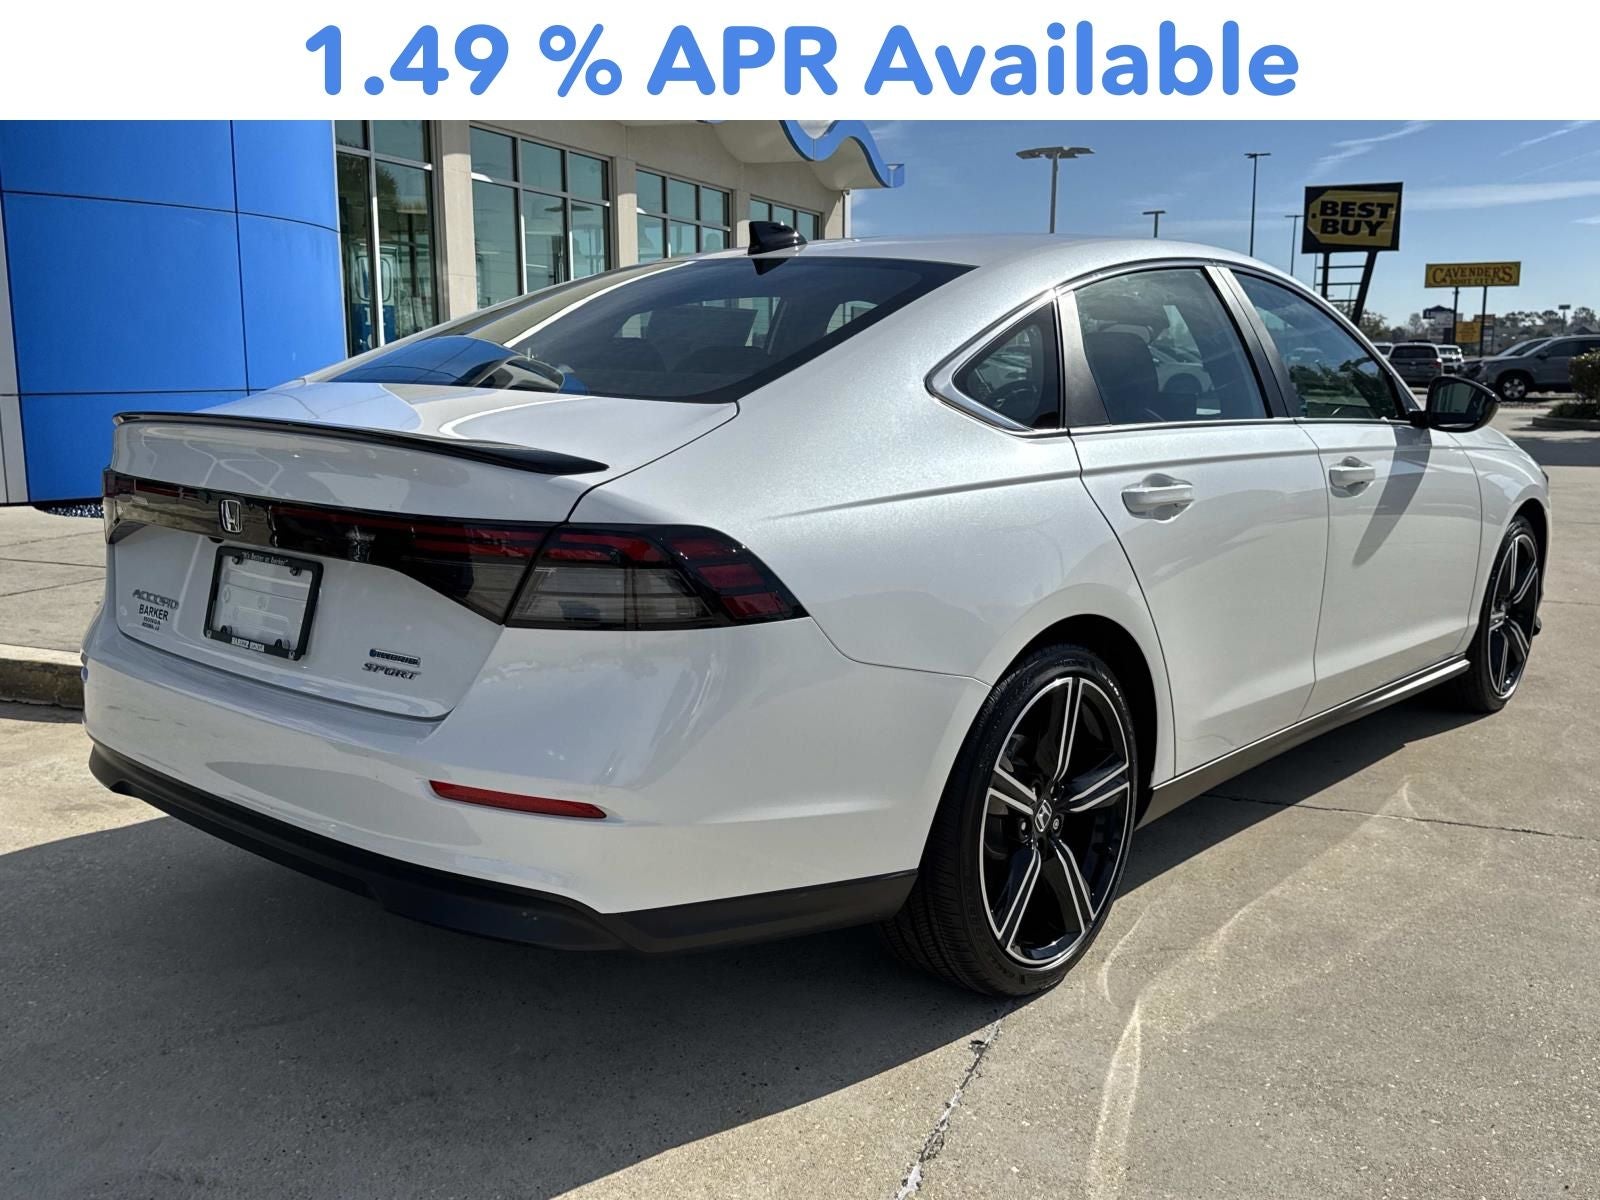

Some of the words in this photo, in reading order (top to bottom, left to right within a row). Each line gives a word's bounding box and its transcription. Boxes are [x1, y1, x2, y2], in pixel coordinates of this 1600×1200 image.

[1320, 200, 1394, 219] BEST
[1320, 218, 1385, 237] BUY
[1432, 265, 1513, 284] CAVENDER'S
[132, 589, 179, 609] ACCORD
[139, 603, 169, 621] BARKER
[362, 662, 421, 680] SPORT
